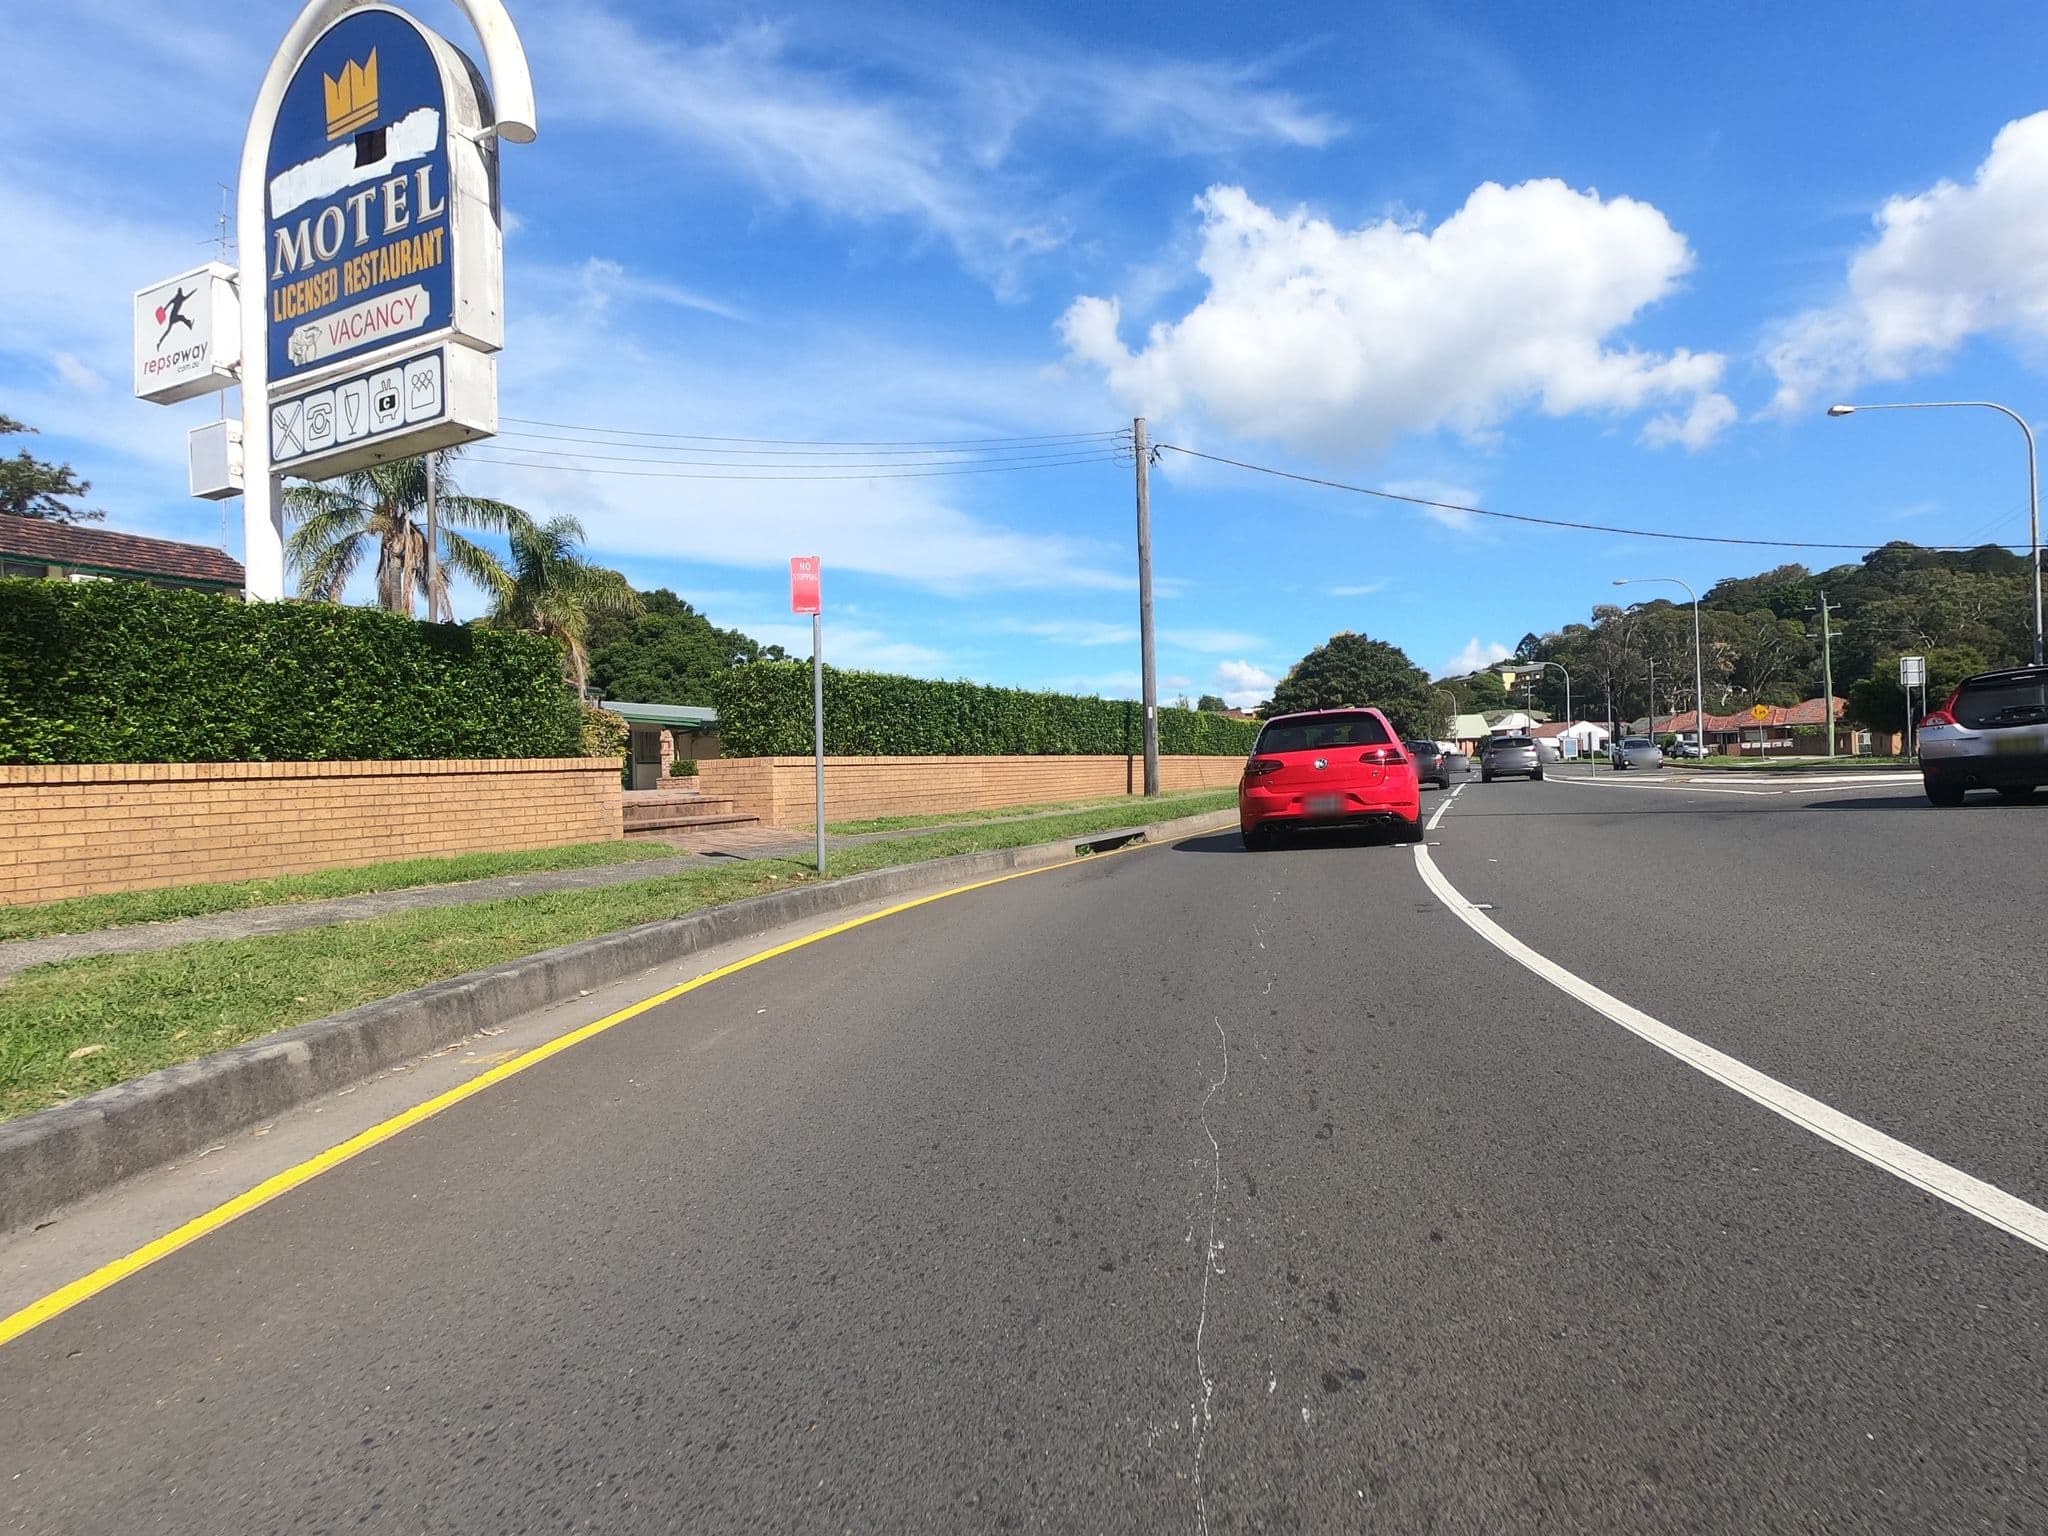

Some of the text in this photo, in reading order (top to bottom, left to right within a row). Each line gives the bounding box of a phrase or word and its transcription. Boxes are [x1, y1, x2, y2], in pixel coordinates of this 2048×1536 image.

[272, 165, 444, 280] MOTEL
[273, 228, 444, 322] LICENSED RESTAURANT
[329, 294, 418, 346] VACANCY
[799, 562, 811, 571] NO
